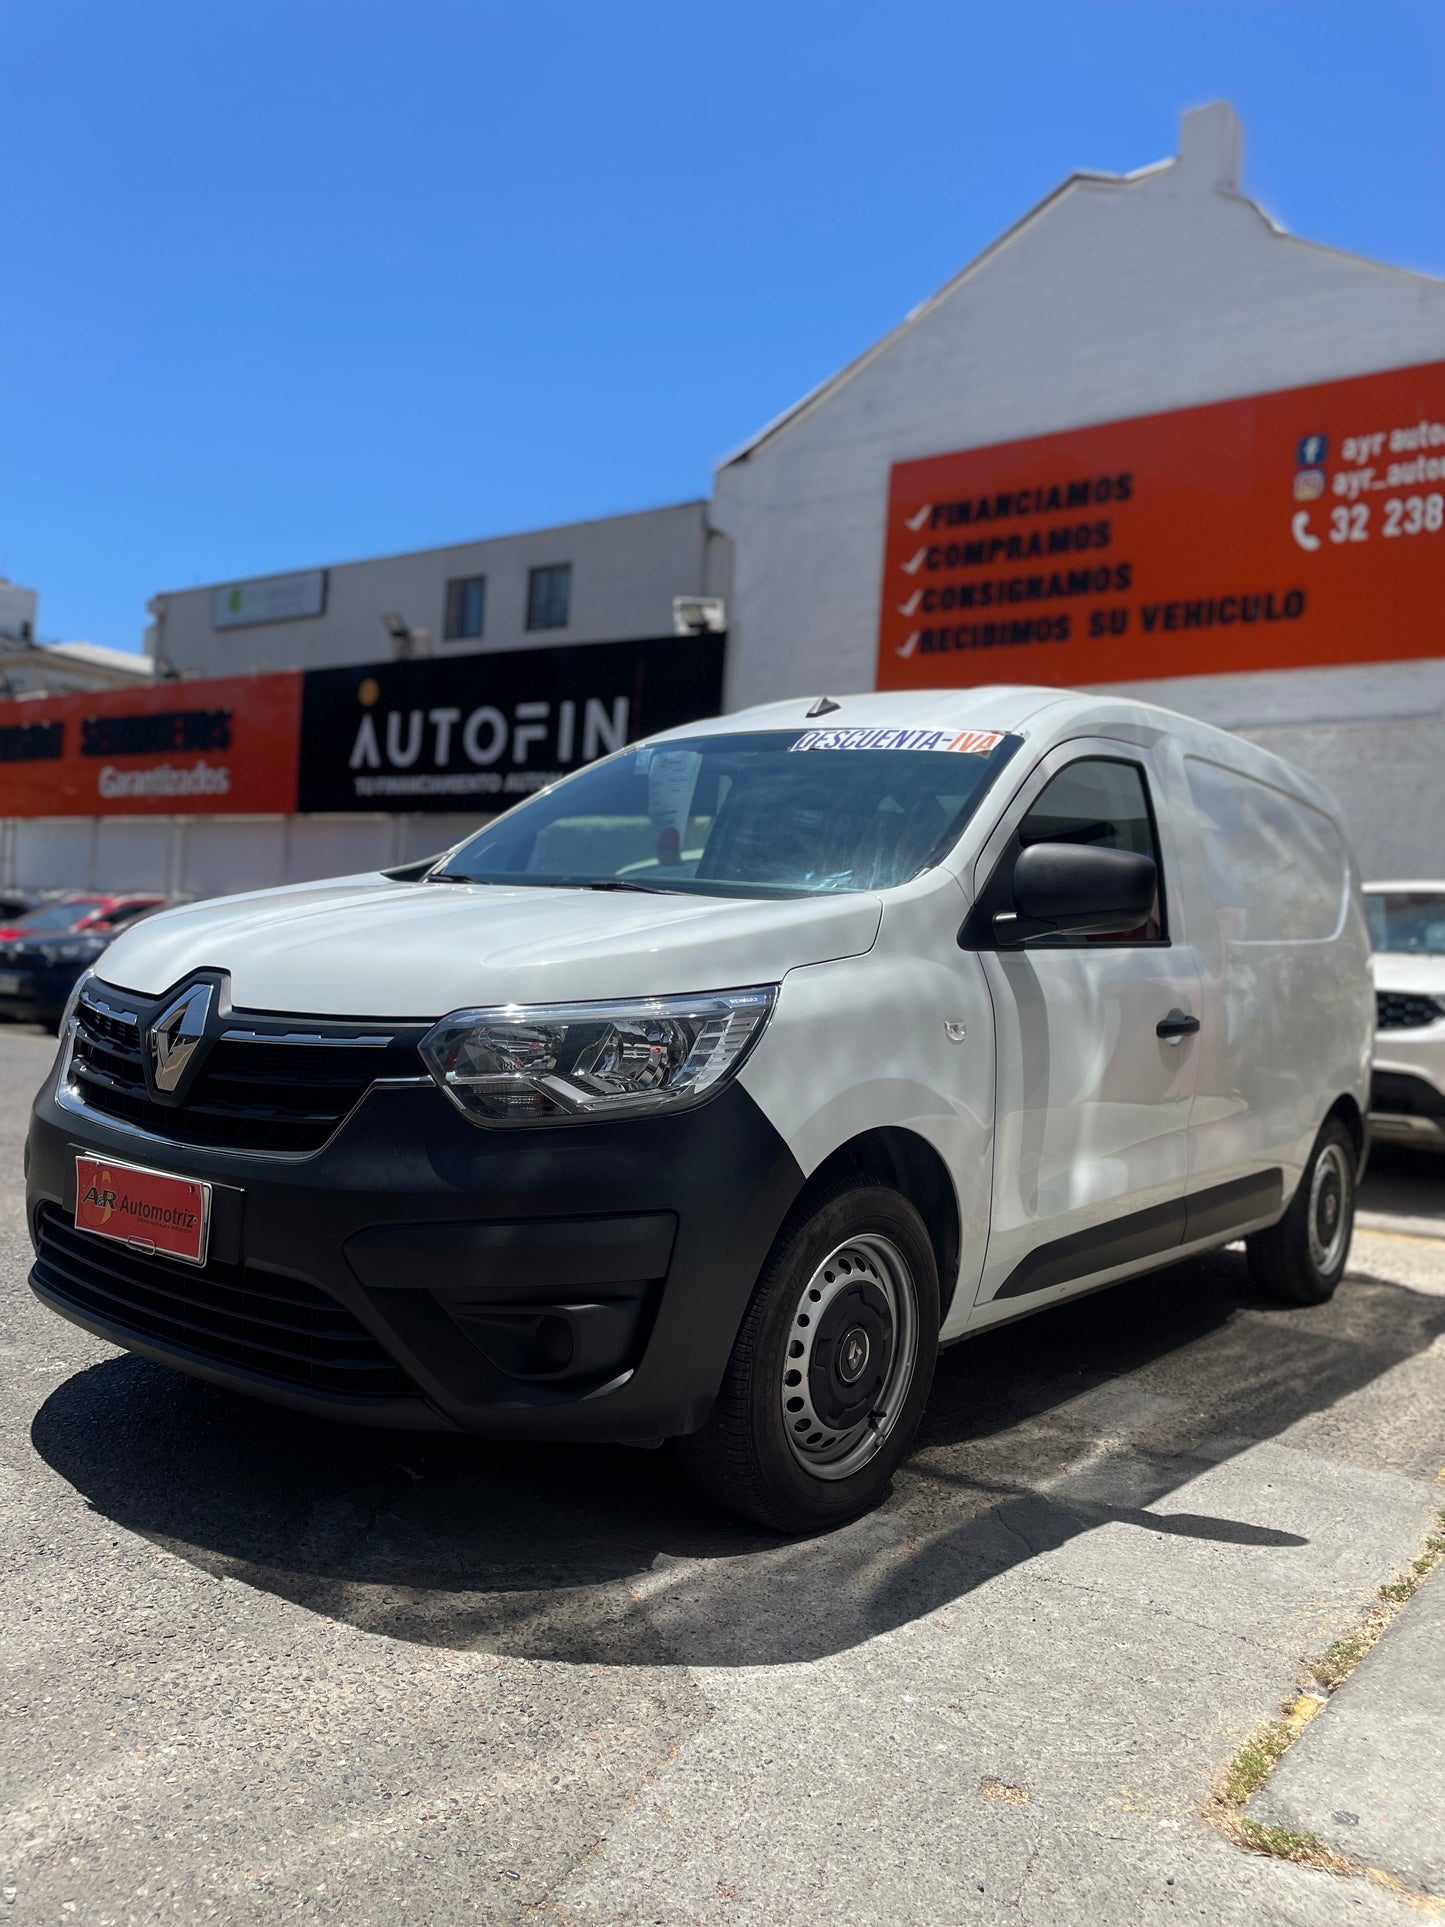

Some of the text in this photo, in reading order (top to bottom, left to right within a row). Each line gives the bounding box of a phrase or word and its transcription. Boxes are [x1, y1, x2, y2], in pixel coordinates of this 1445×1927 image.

[1341, 419, 1445, 465] ayr auto
[928, 472, 1133, 531] FINANCIAMOS
[1332, 454, 1445, 500] ayr_auto
[1329, 492, 1444, 544] 32 238
[924, 520, 1112, 572] COMPRAMOS
[920, 563, 1133, 614] CONSIGNAMOS
[918, 588, 1306, 655] RECIBIMOS SU VEHICULO
[349, 696, 630, 769] AUTOFIN
[98, 760, 229, 798] Garantizados
[120, 1194, 197, 1229] Automotriz
